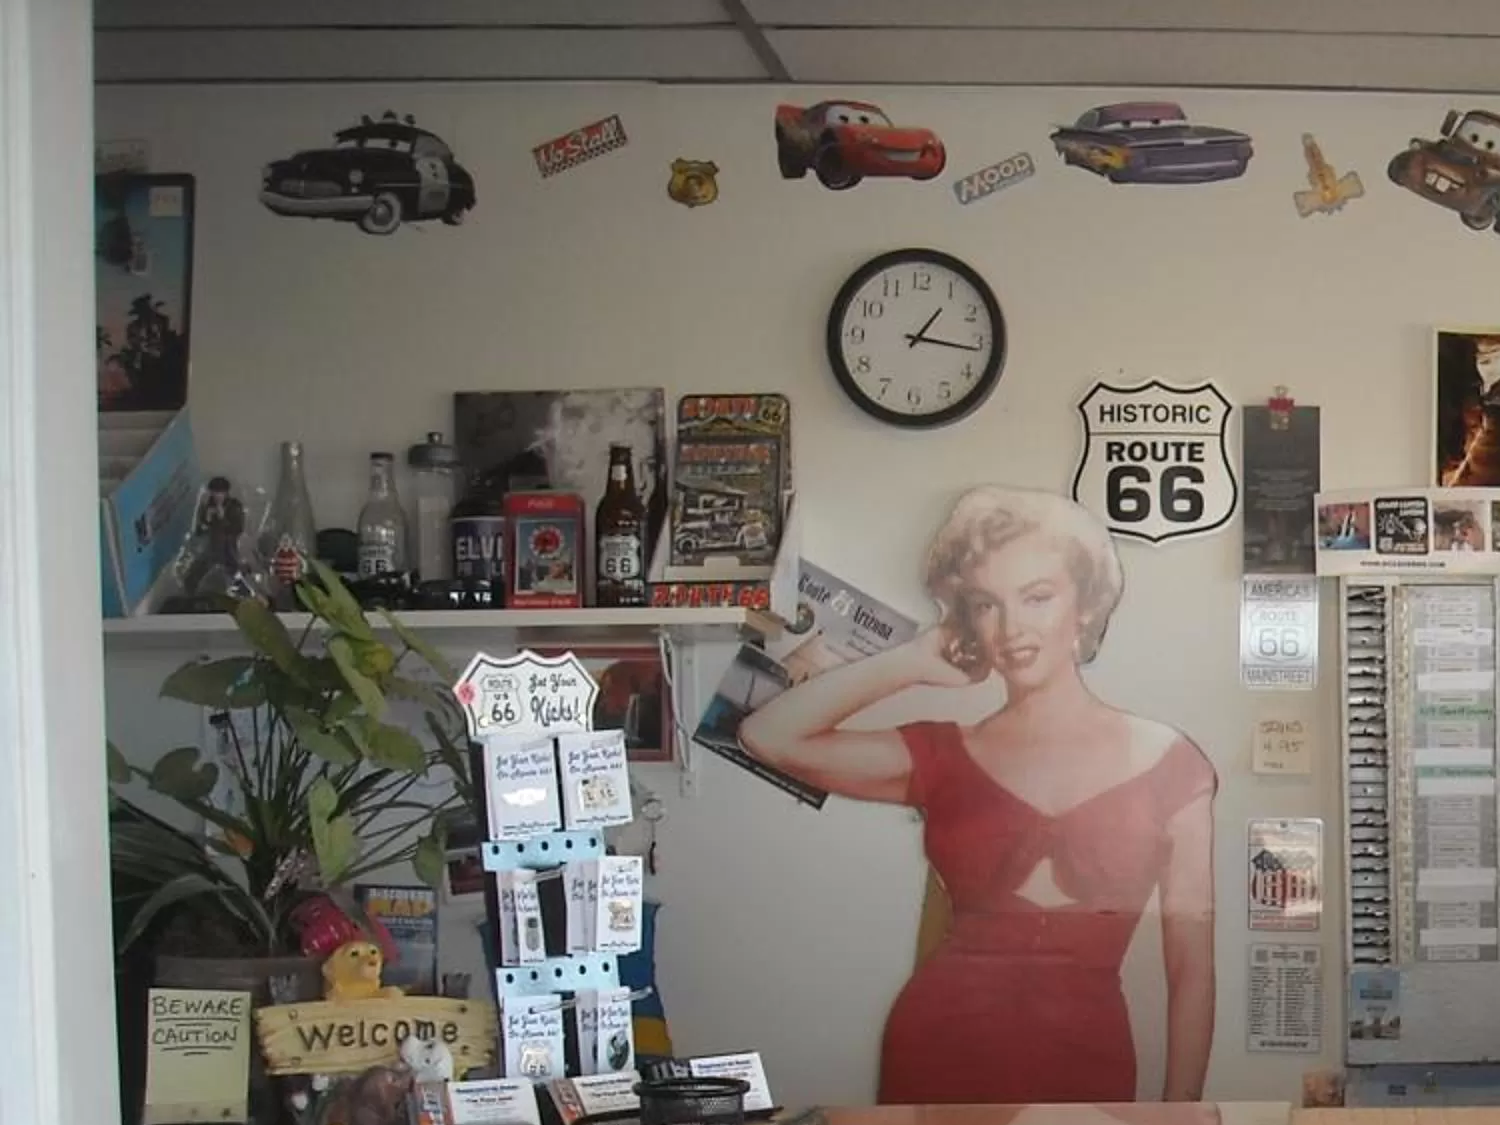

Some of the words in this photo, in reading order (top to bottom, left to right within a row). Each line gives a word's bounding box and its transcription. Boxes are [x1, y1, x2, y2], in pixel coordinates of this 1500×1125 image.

[882, 278, 899, 297] 11
[913, 271, 931, 291] 12
[863, 300, 884, 318] 10
[964, 303, 977, 323] 2
[851, 326, 865, 345] 9
[857, 356, 871, 373] 8
[960, 362, 973, 380] 4
[880, 377, 892, 397] 7
[907, 388, 921, 406] 6
[937, 380, 951, 400] 5
[1100, 404, 1212, 424] HISTORIC
[1106, 441, 1205, 462] ROUTE
[1106, 465, 1205, 523] 66
[456, 536, 503, 560] ELVI
[606, 556, 633, 575] 66
[738, 586, 770, 609] 66
[1259, 610, 1298, 622] ROUTE
[1258, 627, 1301, 657] 66
[487, 678, 513, 688] ROUTE
[550, 673, 577, 692] Your
[491, 703, 516, 722] 66
[530, 695, 580, 728] Kicks!
[151, 995, 244, 1018] BEWARE
[297, 1018, 459, 1051] Welcome
